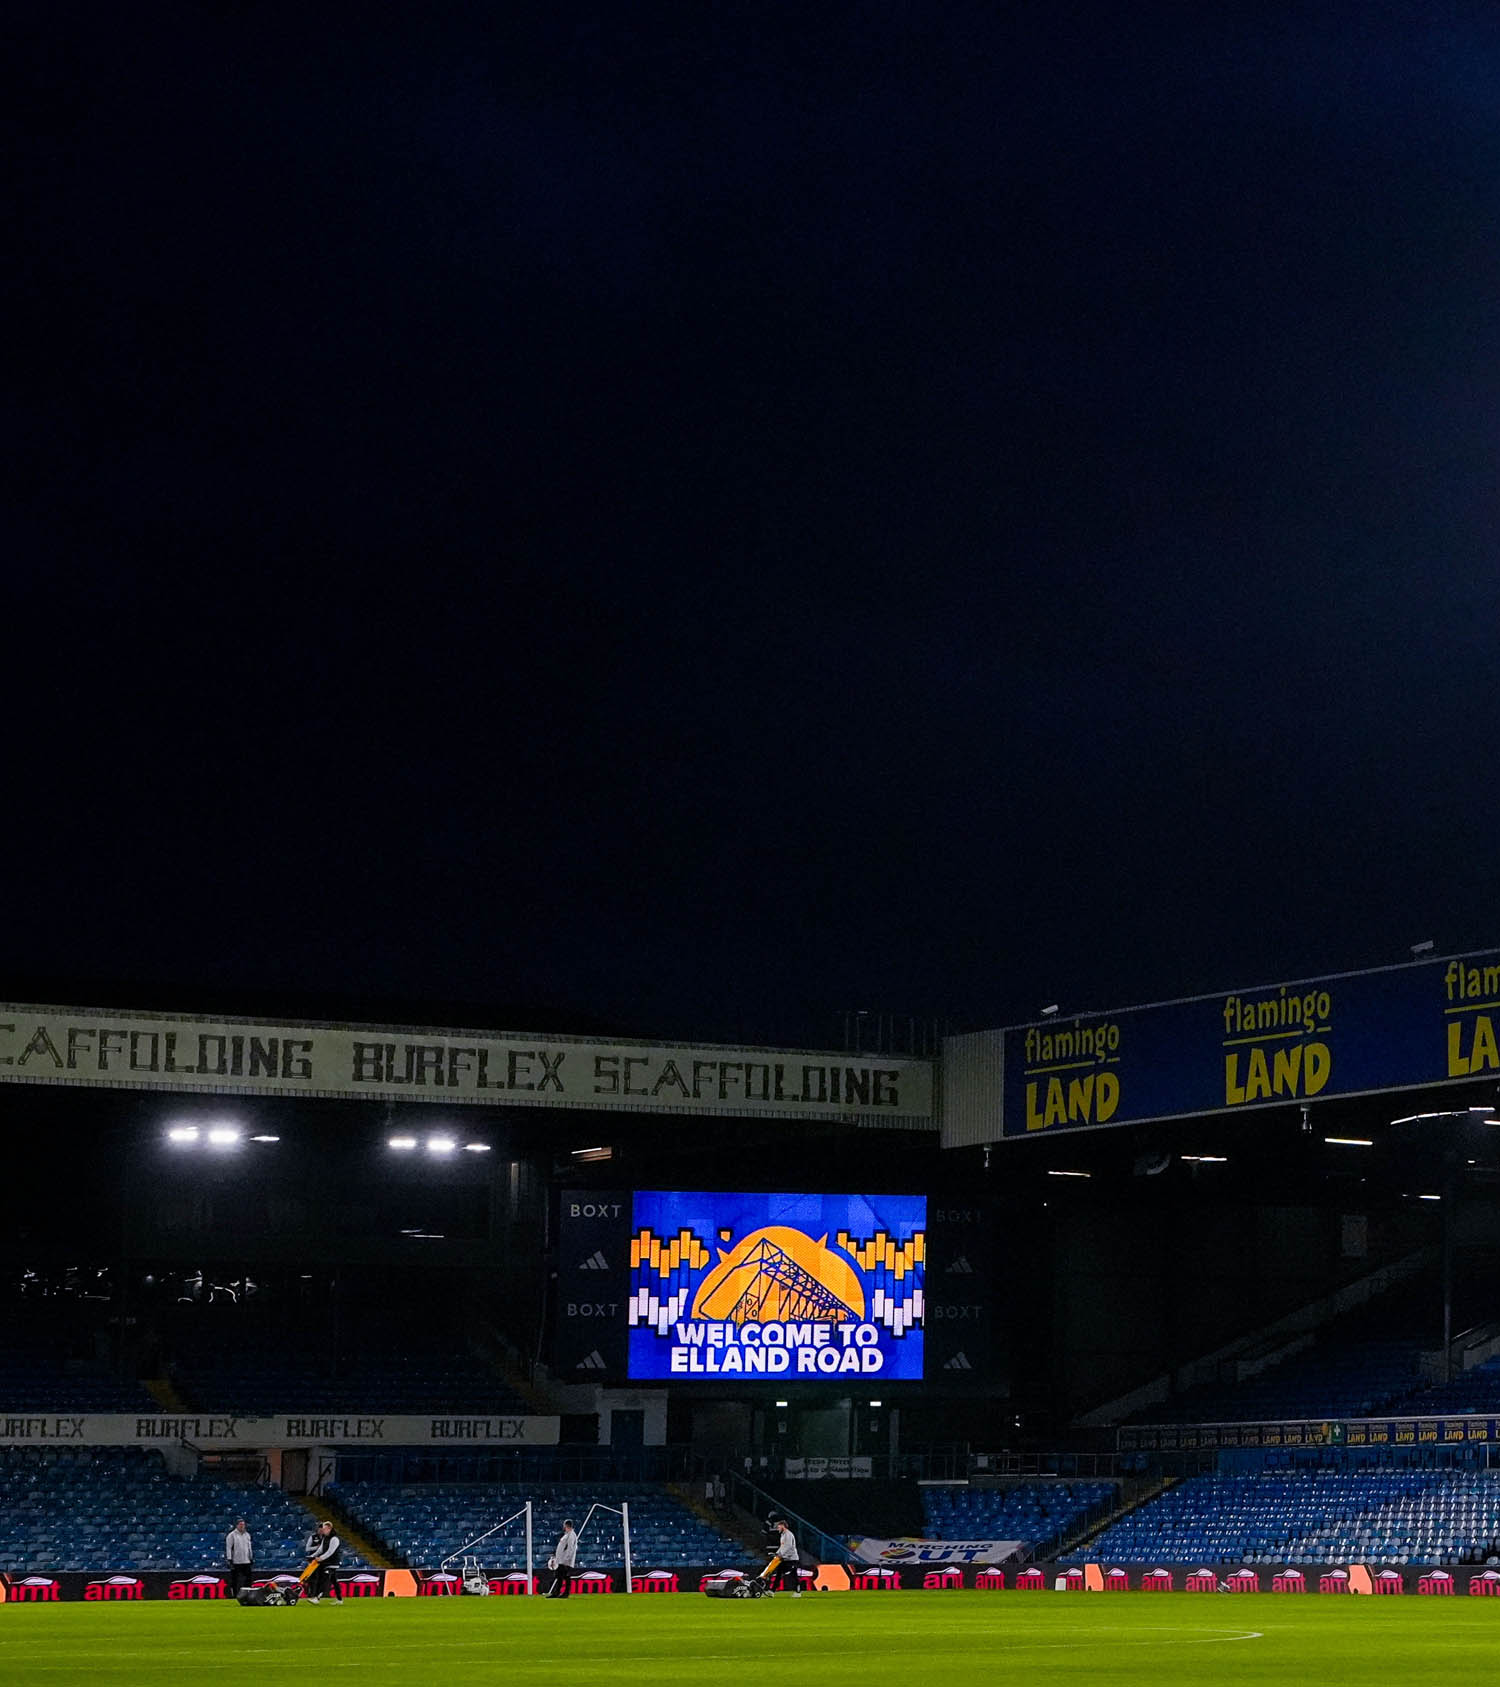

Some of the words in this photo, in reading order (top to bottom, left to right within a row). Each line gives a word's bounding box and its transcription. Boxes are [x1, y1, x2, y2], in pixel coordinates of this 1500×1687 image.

[1223, 987, 1332, 1034] flamingo
[1025, 1020, 1120, 1062] flamingo
[353, 1042, 566, 1092] BURFLEX
[594, 1055, 899, 1107] SCAFFOLDING
[1225, 1042, 1332, 1107] LAND
[1026, 1072, 1120, 1131] LAND
[570, 1204, 622, 1218] BOXT
[568, 1303, 618, 1317] BOXT
[676, 1323, 831, 1348] WELCOME
[838, 1324, 879, 1347] TO
[670, 1347, 792, 1372] ELLAND
[798, 1347, 884, 1372] ROAD
[136, 1418, 238, 1438] BURFLEX
[287, 1418, 384, 1438] BURFLEX
[431, 1419, 524, 1438] BURFLEX
[889, 1542, 993, 1550] MARCHING
[84, 1580, 144, 1601] amt
[168, 1579, 229, 1600] amt
[631, 1574, 679, 1593] amt
[976, 1570, 1006, 1590] amt
[1016, 1570, 1045, 1590] amt
[1141, 1571, 1174, 1591] amt
[1185, 1571, 1218, 1592] amt
[1226, 1571, 1259, 1592] amt
[1272, 1572, 1305, 1592] amt
[1417, 1573, 1455, 1595] amt
